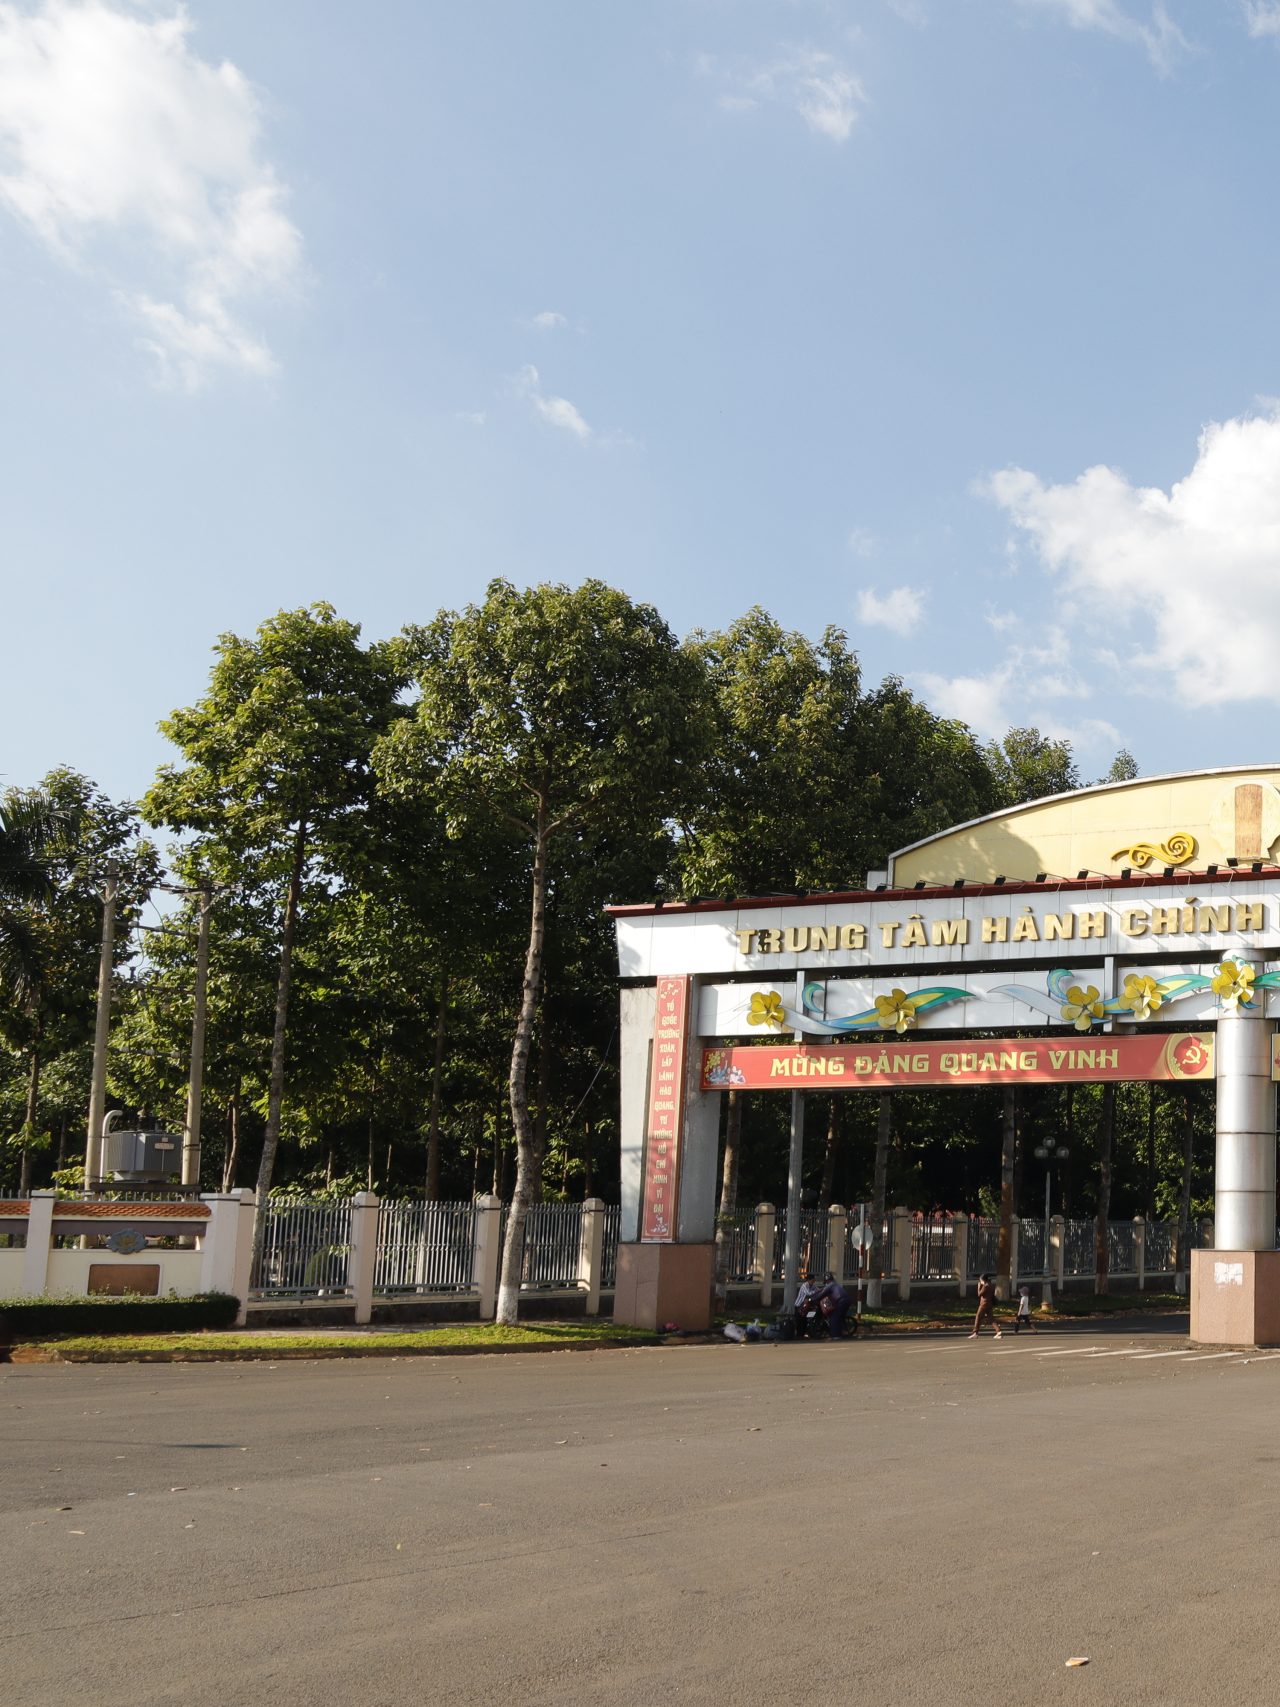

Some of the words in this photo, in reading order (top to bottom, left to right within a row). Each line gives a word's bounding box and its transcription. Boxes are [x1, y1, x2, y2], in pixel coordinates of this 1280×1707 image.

[735, 923, 868, 954] TRUNG
[879, 912, 967, 948] TÂM
[979, 906, 1107, 944] HÀNH
[1120, 896, 1264, 937] CHÍNH
[769, 1052, 846, 1077] MỪNG
[854, 1049, 929, 1075] ĐẢNG
[939, 1051, 1038, 1076] QUANG
[1048, 1049, 1119, 1070] VINH
